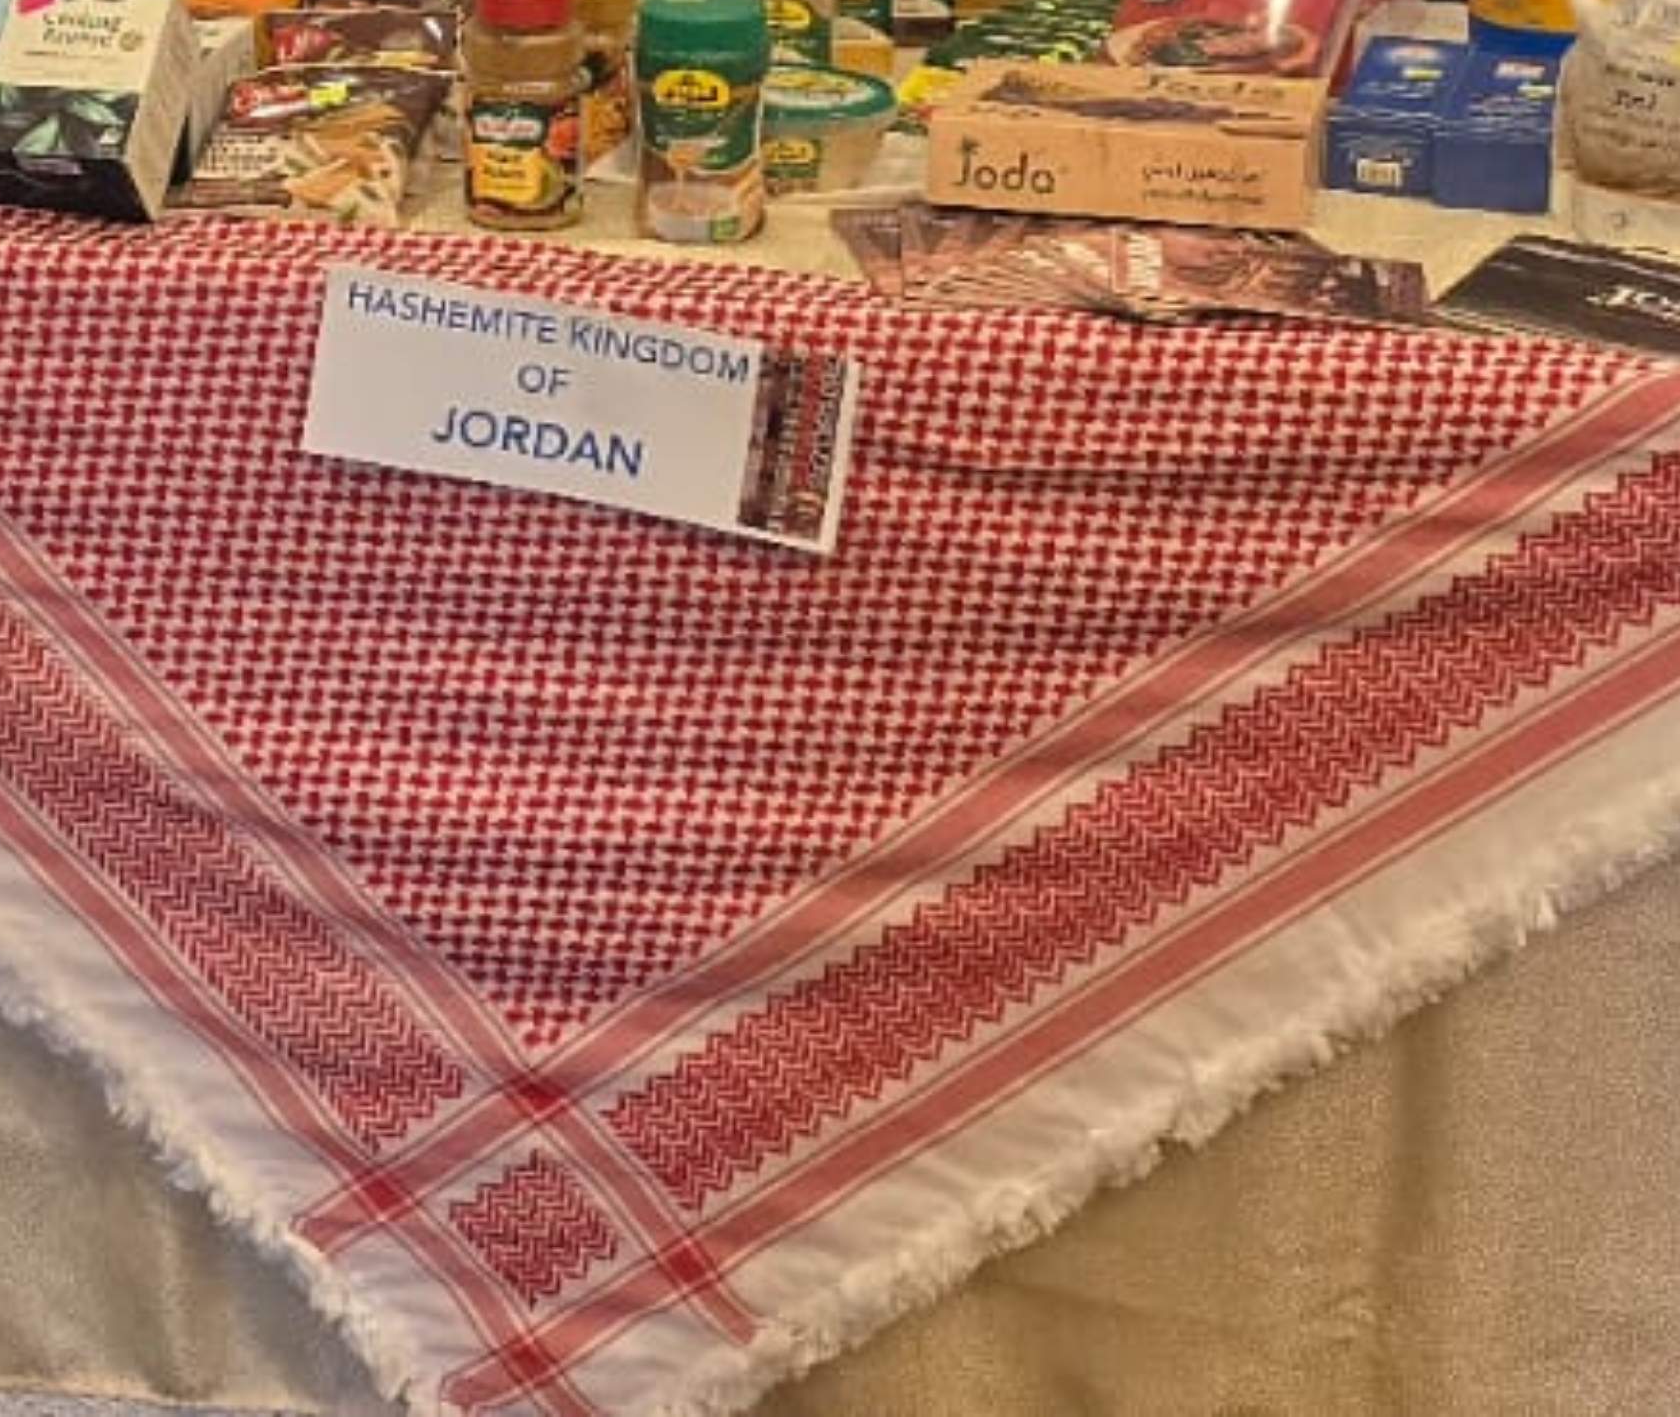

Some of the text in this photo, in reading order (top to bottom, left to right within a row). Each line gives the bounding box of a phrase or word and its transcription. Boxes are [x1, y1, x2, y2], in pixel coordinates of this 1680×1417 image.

[347, 282, 750, 383] HASHEMITE KINGDOM
[515, 364, 570, 397] OF
[432, 407, 644, 477] JORDAN
